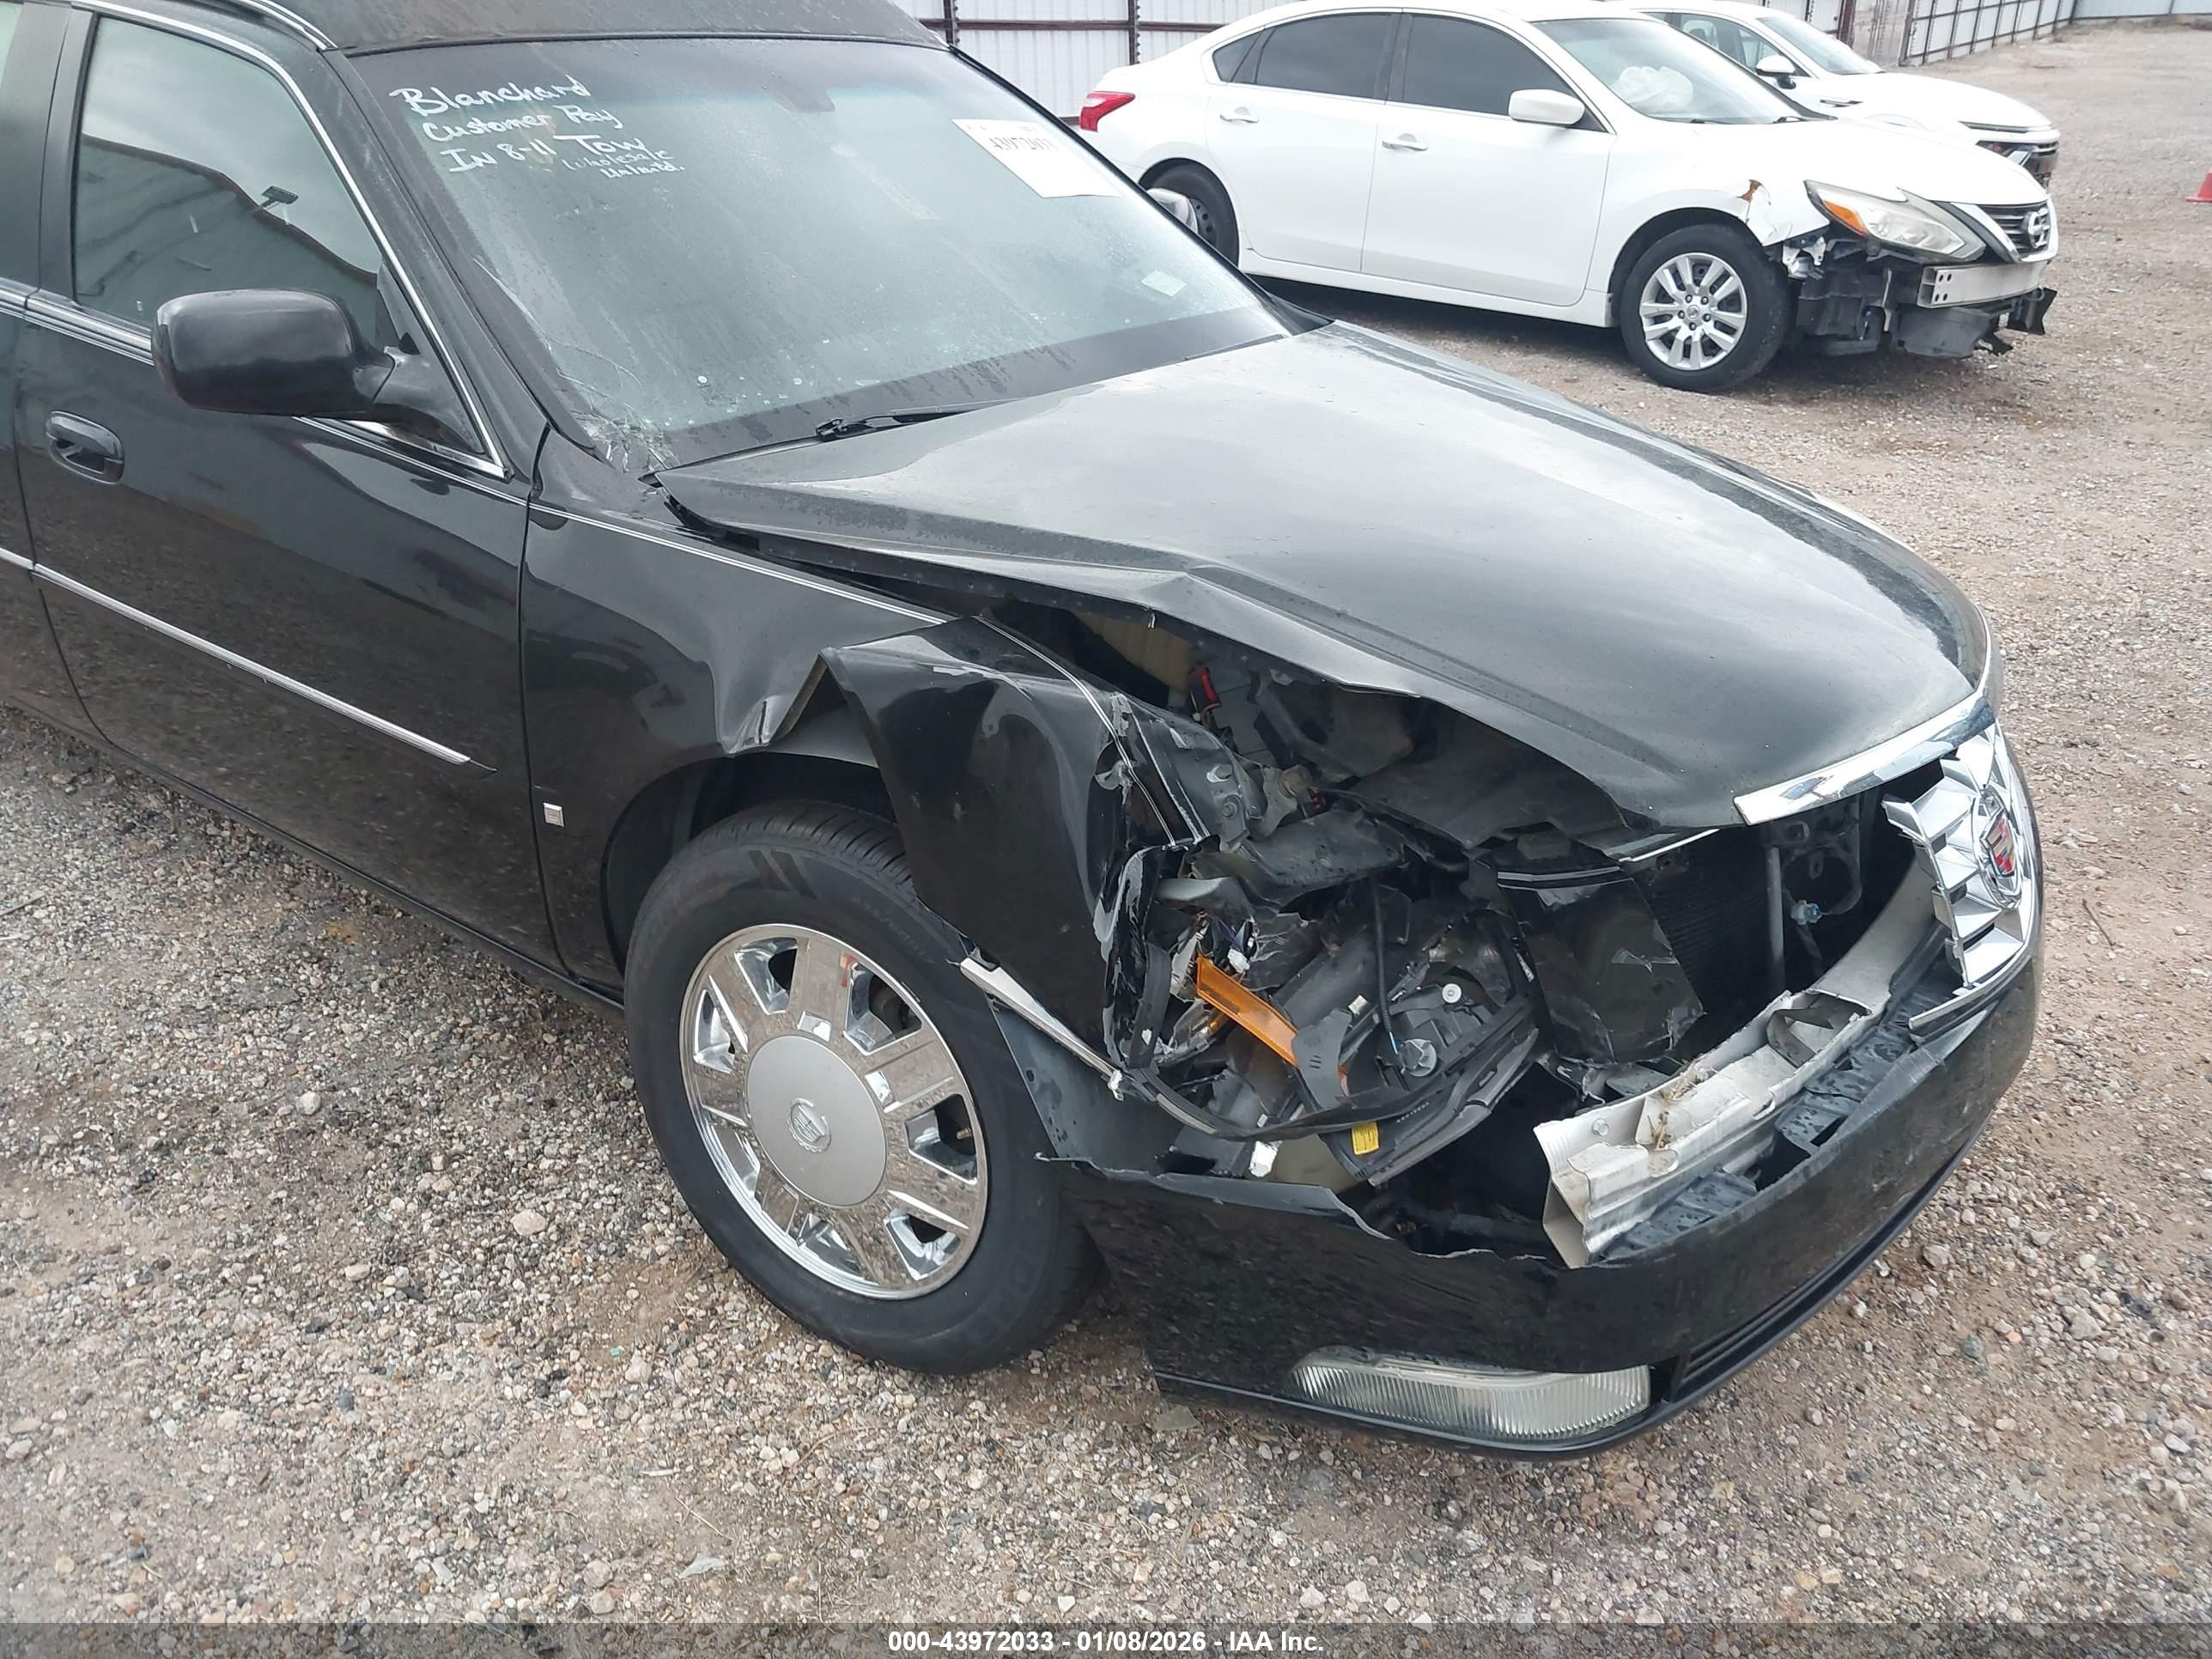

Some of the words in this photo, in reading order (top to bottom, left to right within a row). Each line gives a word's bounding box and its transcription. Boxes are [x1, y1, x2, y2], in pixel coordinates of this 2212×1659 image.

[389, 75, 591, 117] Blanchard
[422, 114, 555, 142] Customer
[553, 105, 623, 130] Pay
